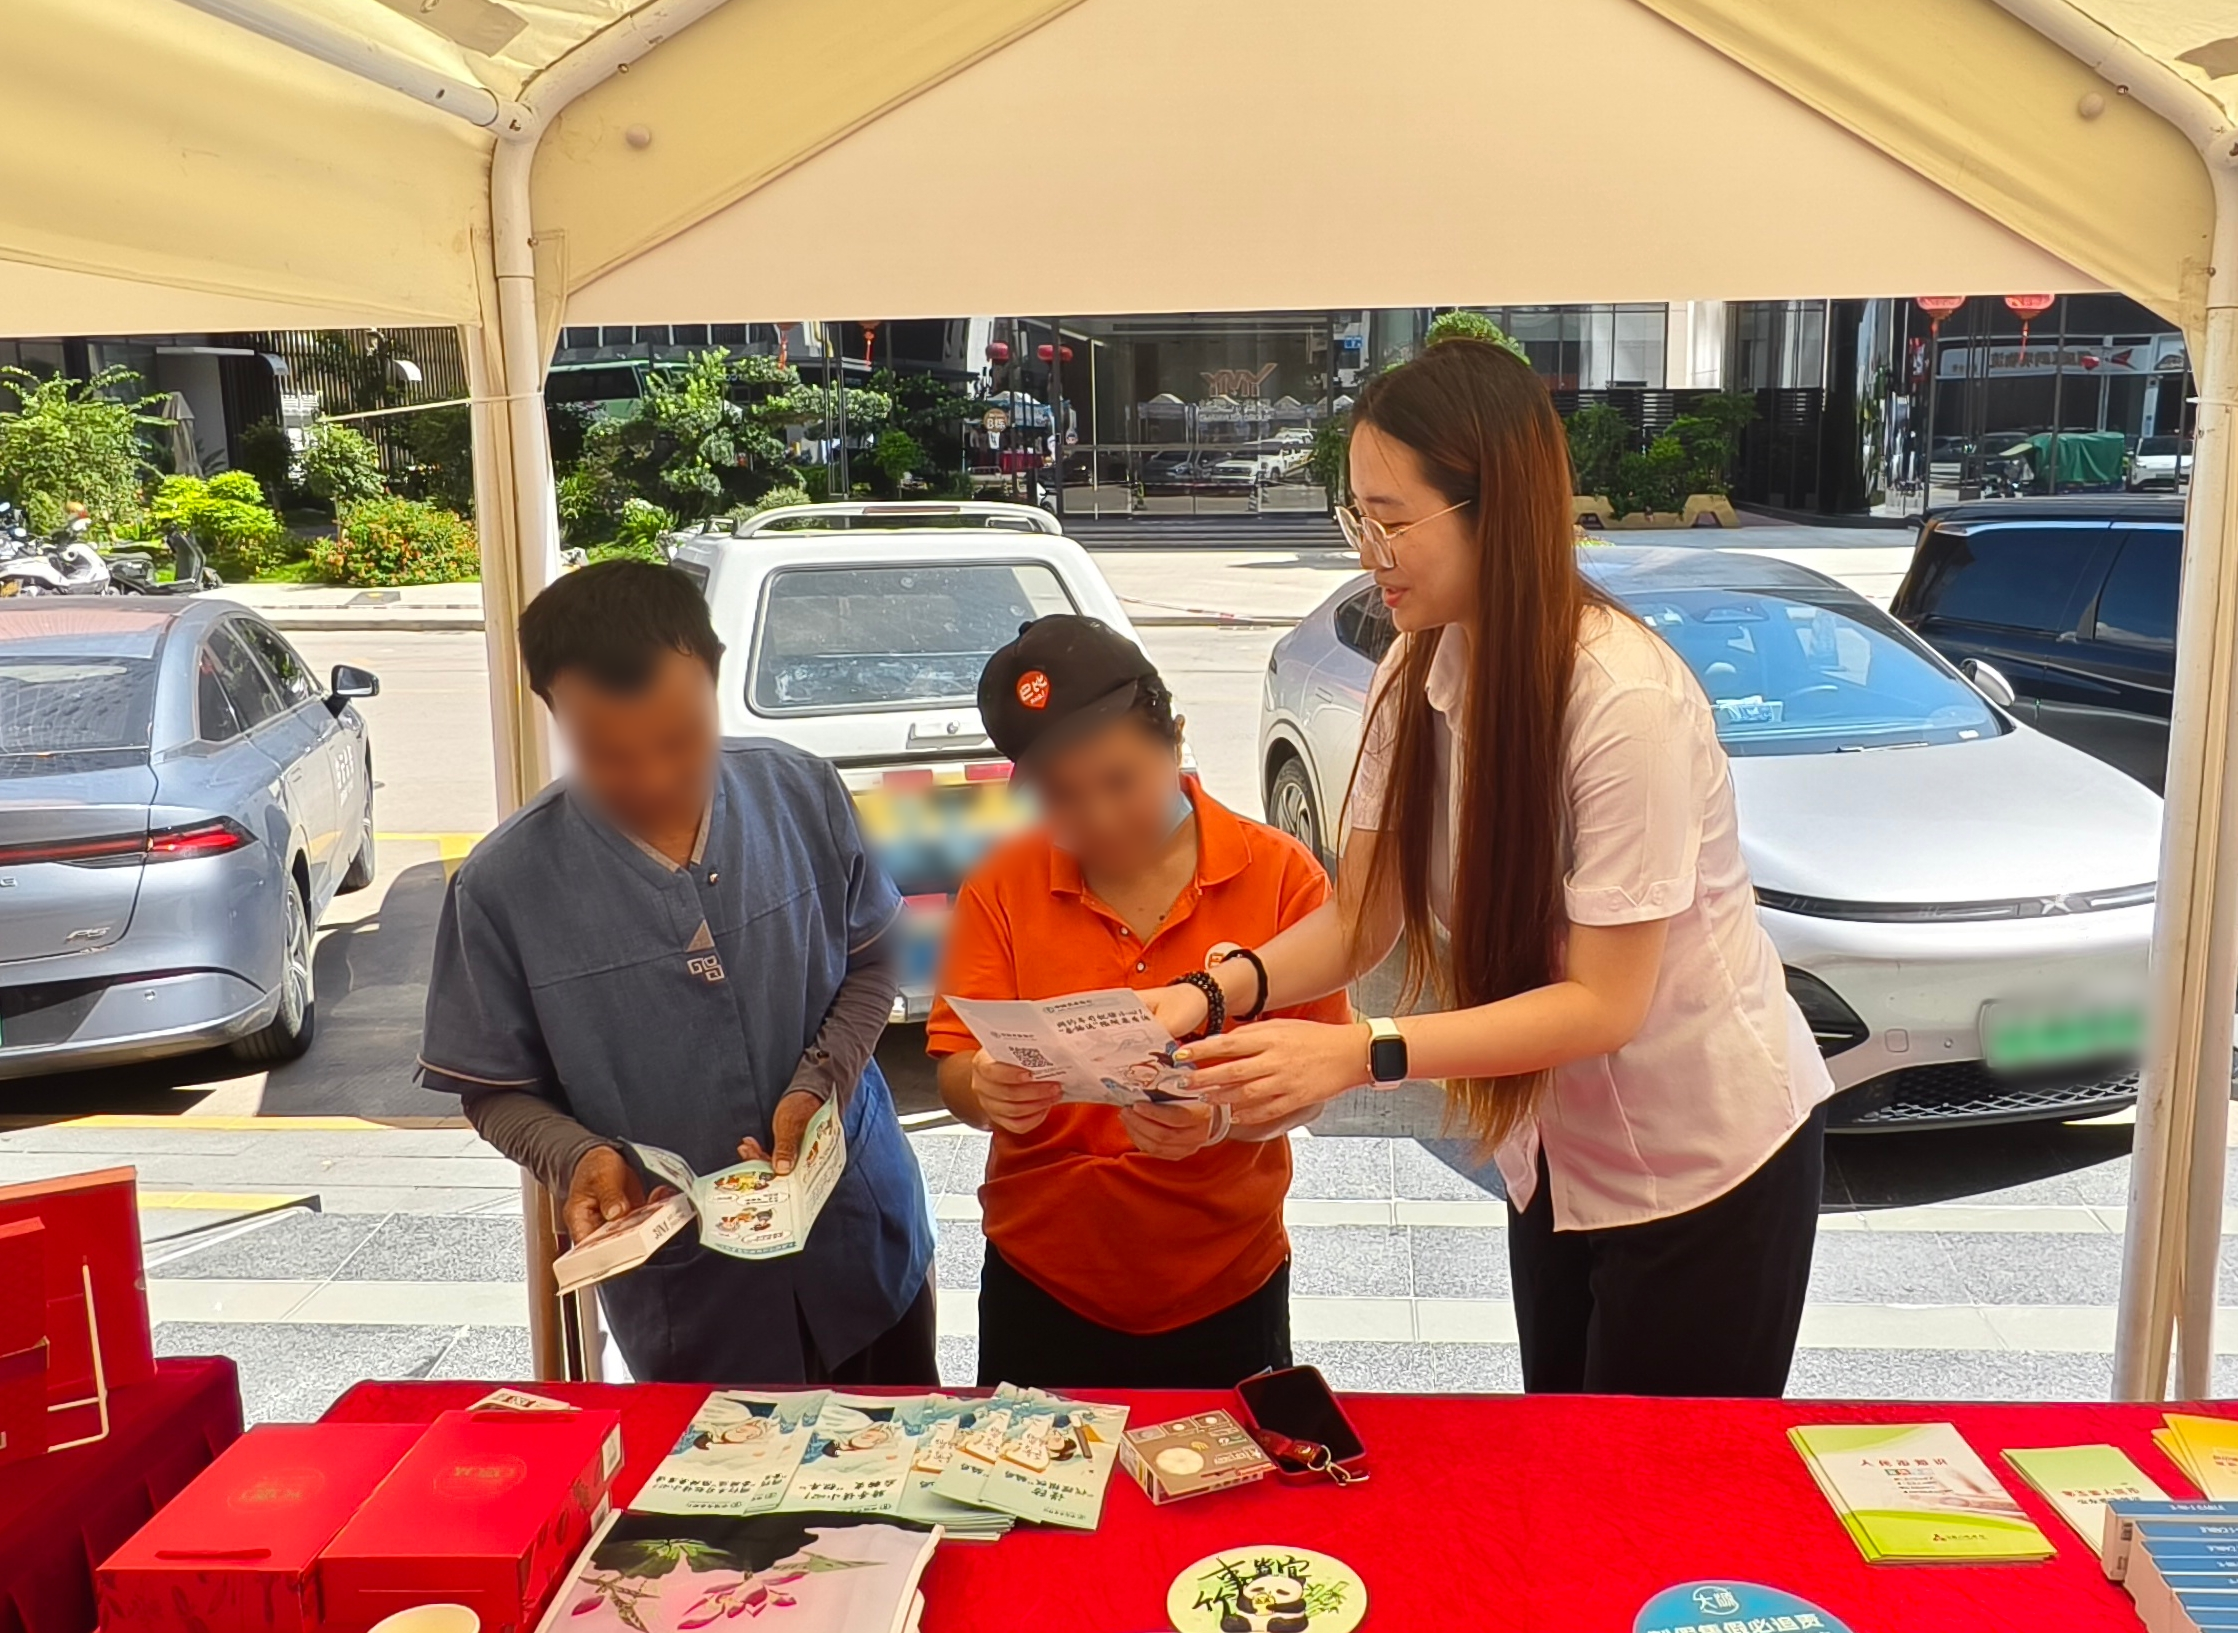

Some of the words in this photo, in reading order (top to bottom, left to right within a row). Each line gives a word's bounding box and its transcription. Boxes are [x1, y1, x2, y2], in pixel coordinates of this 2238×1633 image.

[1859, 1457, 1948, 1467] 人民币知识
